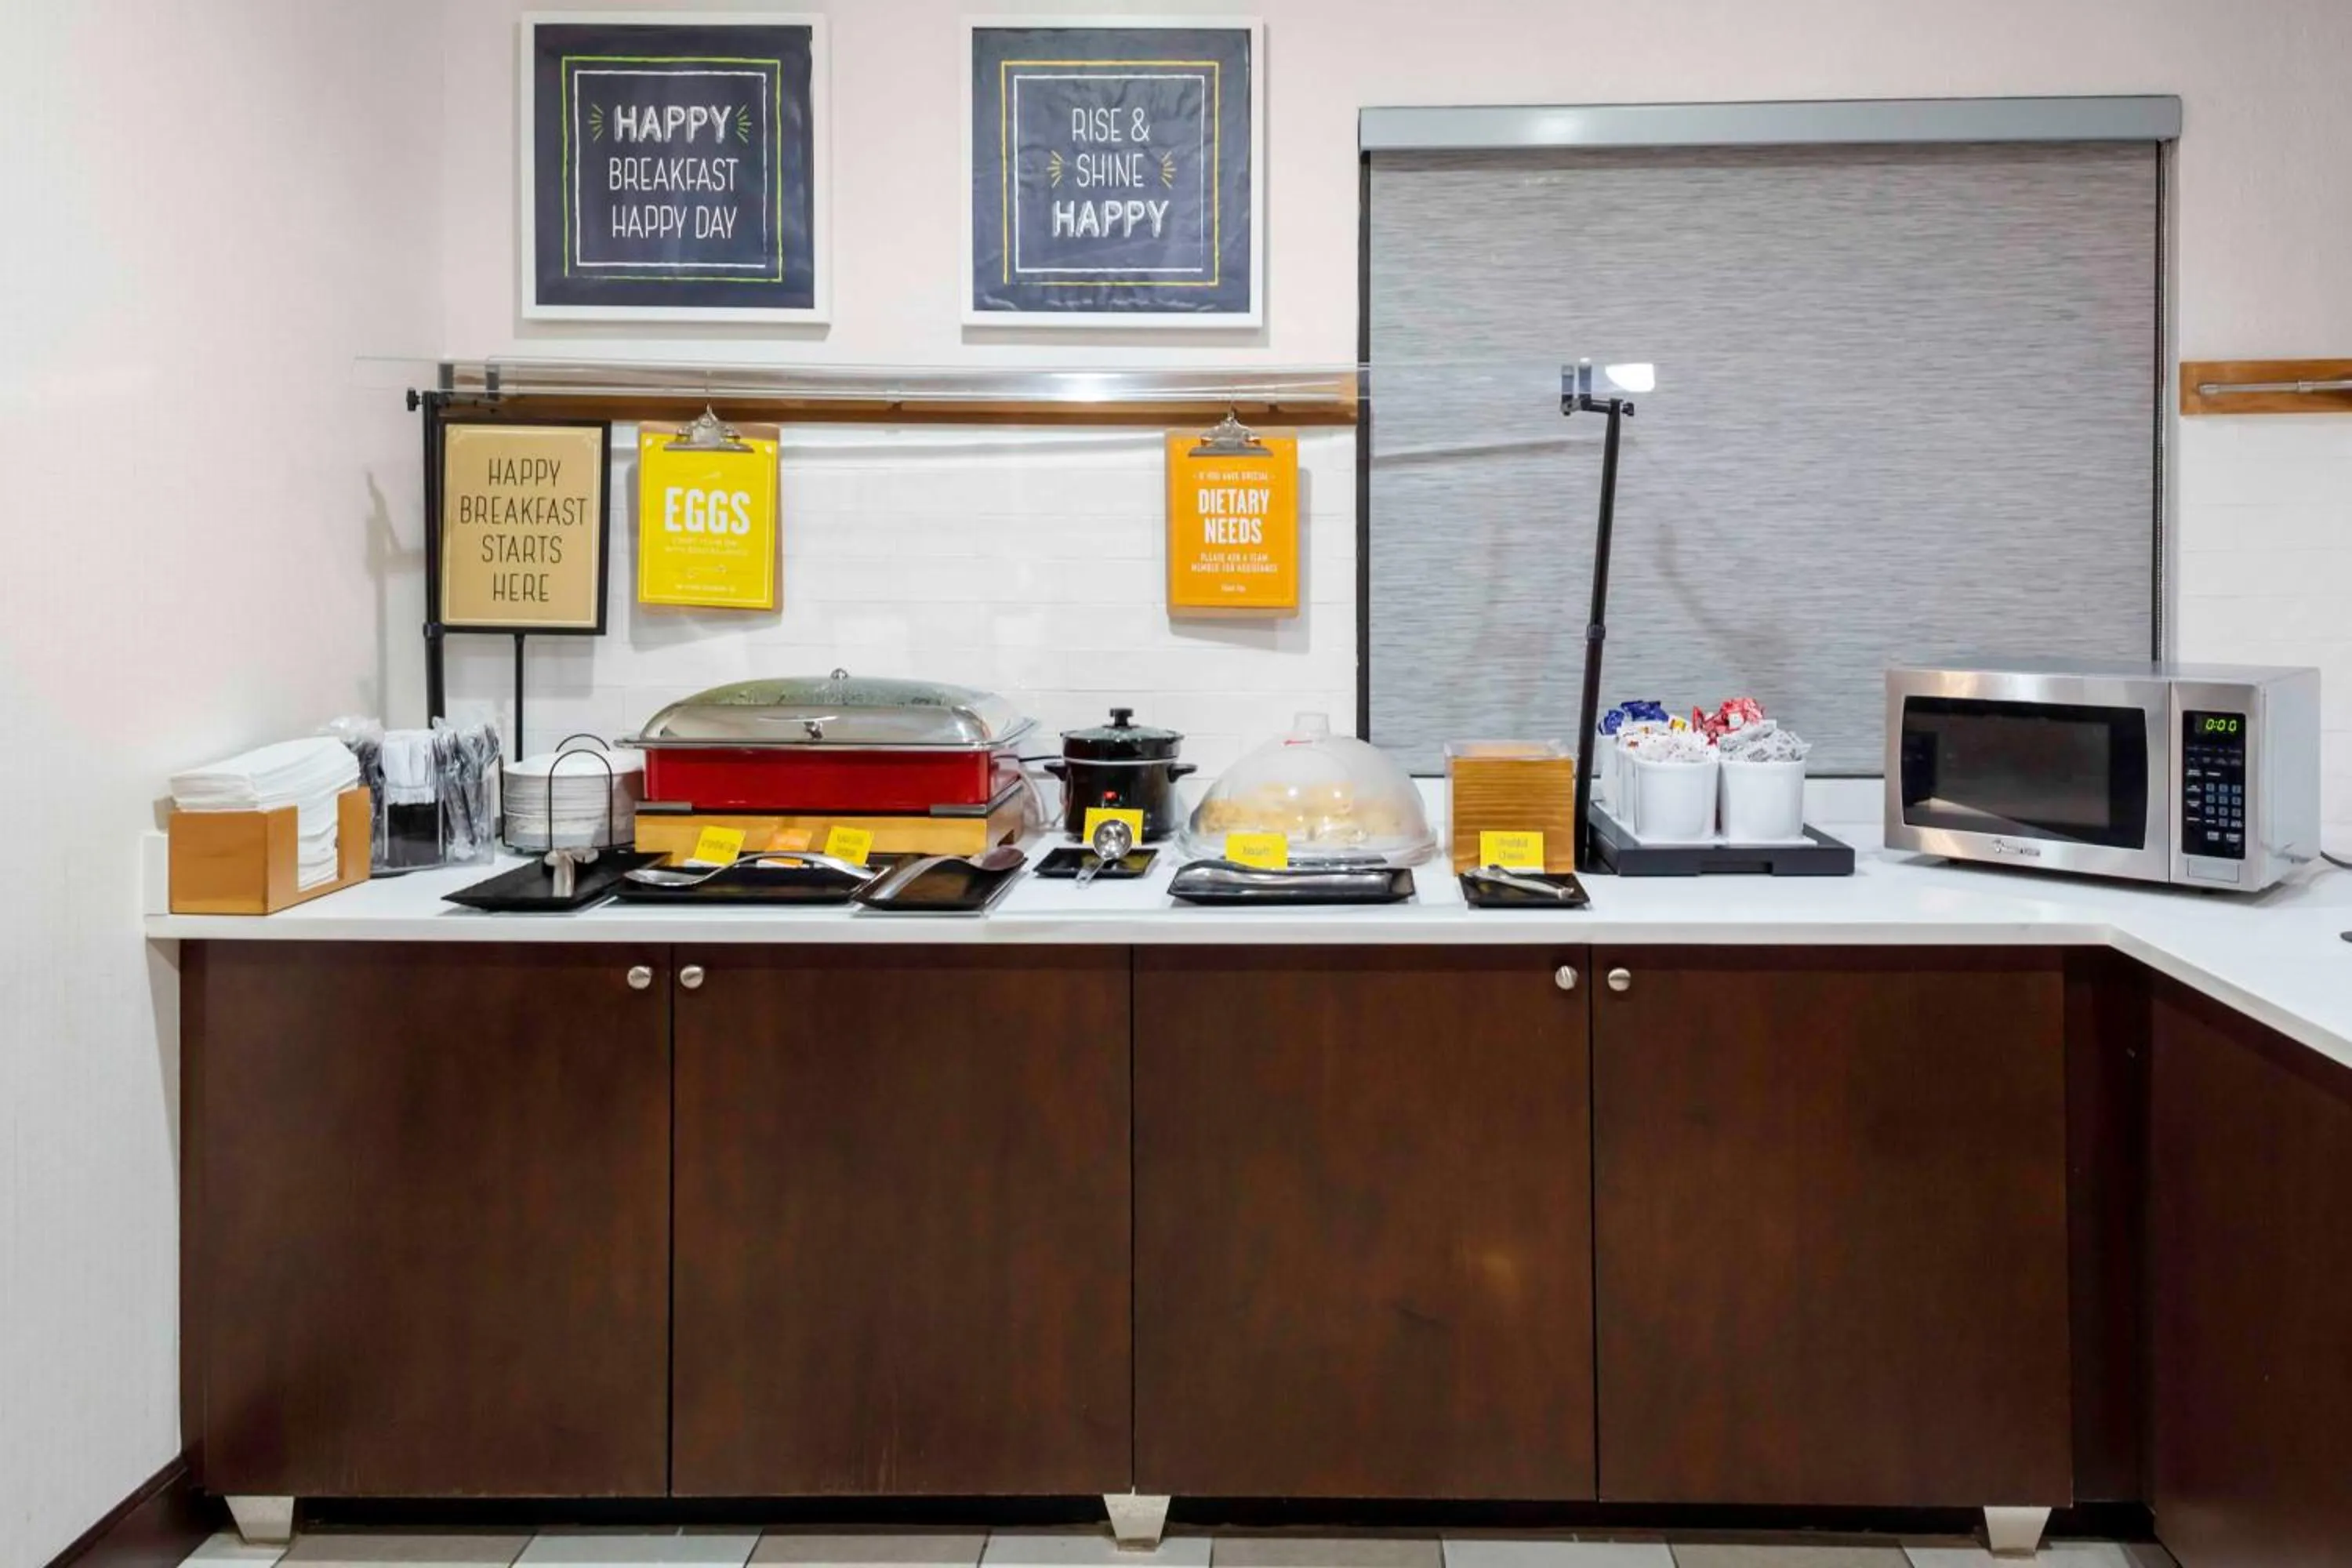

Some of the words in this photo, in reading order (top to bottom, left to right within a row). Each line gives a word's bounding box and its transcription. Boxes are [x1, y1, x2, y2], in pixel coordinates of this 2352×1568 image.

[614, 104, 732, 143] HAPPY
[1072, 107, 1122, 143] RISE
[1130, 107, 1151, 143] &
[609, 158, 739, 191] BREAKFAST
[1076, 153, 1145, 188] SHINE
[612, 205, 688, 239] HAPPY
[695, 205, 738, 239] DAY
[1051, 199, 1170, 238] HAPPY
[488, 457, 561, 488] HAPPY
[459, 495, 588, 526] BREAKFAST
[664, 487, 751, 535] EGGS
[1197, 488, 1270, 514] DIETARY
[1203, 517, 1263, 544] NEEDS
[481, 534, 563, 564] STARTS
[492, 572, 550, 602] HERE
